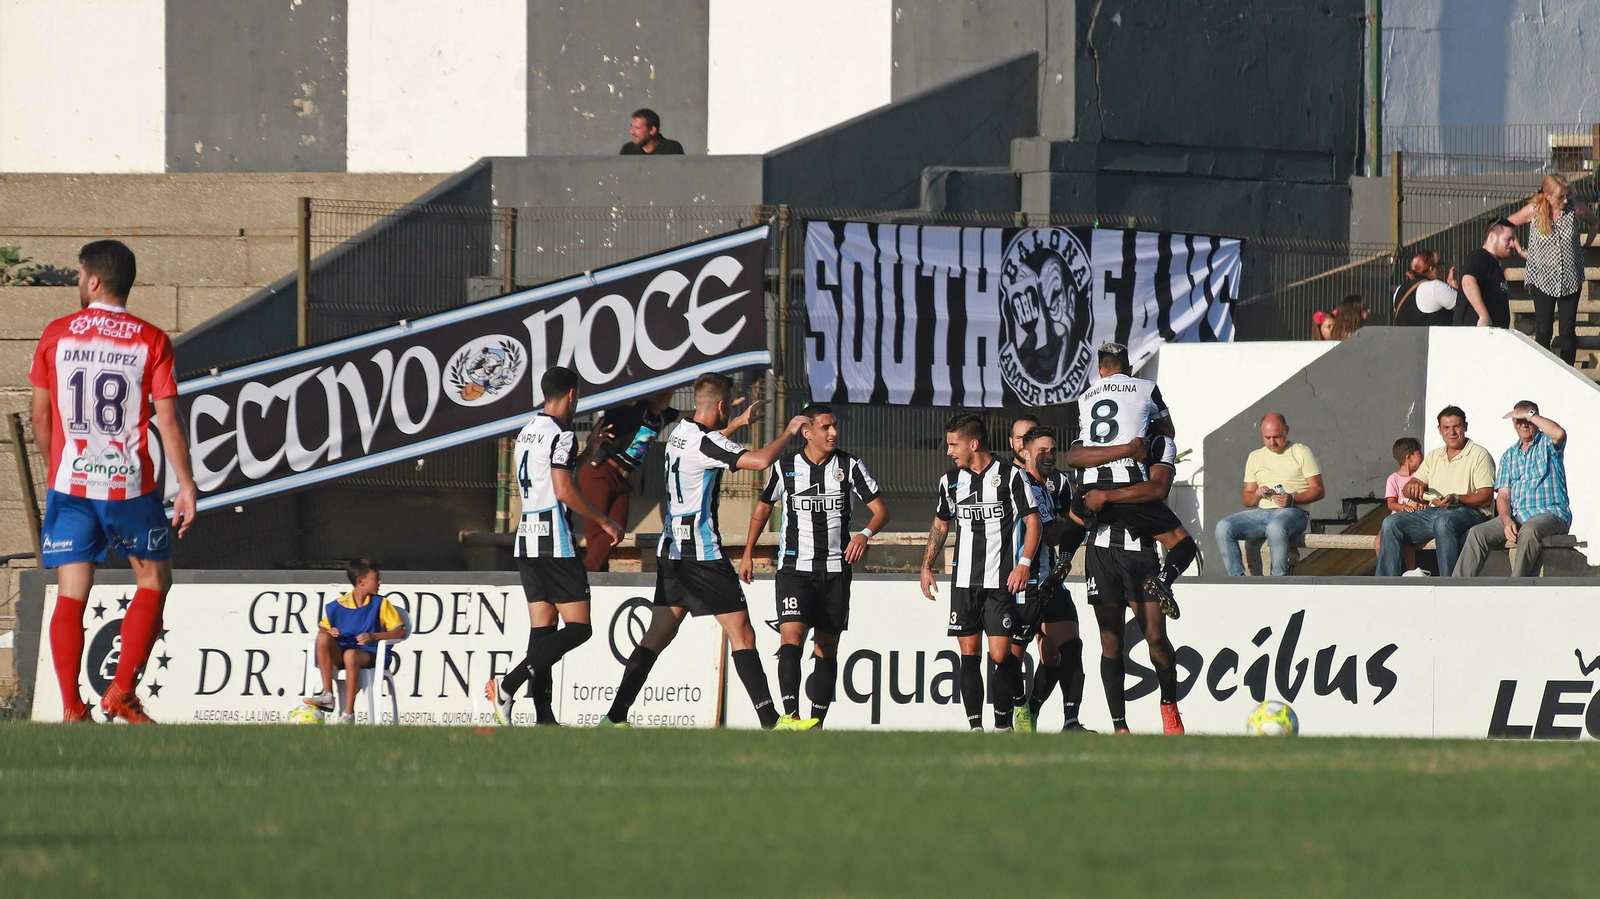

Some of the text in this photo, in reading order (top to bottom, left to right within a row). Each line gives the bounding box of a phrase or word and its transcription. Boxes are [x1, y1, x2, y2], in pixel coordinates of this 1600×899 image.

[1003, 229, 1087, 288] BALONA
[804, 221, 1003, 407] SOUTH
[1013, 291, 1039, 325] RBL
[91, 316, 143, 333] MOTRI
[97, 327, 133, 339] TOOLS
[63, 350, 138, 367] DANI LOPEZ
[1001, 347, 1091, 405] AMOR ETERNO
[1102, 384, 1138, 393] MOLINA
[67, 367, 131, 435] 18
[1090, 399, 1119, 444] 8
[73, 457, 135, 479] Campos
[518, 450, 532, 499] 4
[792, 498, 844, 512] LOTUS
[957, 505, 1004, 520] LOTUS
[782, 597, 798, 610] 18
[950, 611, 957, 624] 3
[194, 648, 285, 697] DR.
[643, 684, 701, 706] puerto
[193, 710, 239, 721] ALGECIRAS
[245, 711, 255, 722] LA
[261, 708, 280, 722] LÍNEA
[400, 711, 436, 723] HOSPITAL
[629, 711, 643, 726] de
[647, 714, 695, 727] seguros
